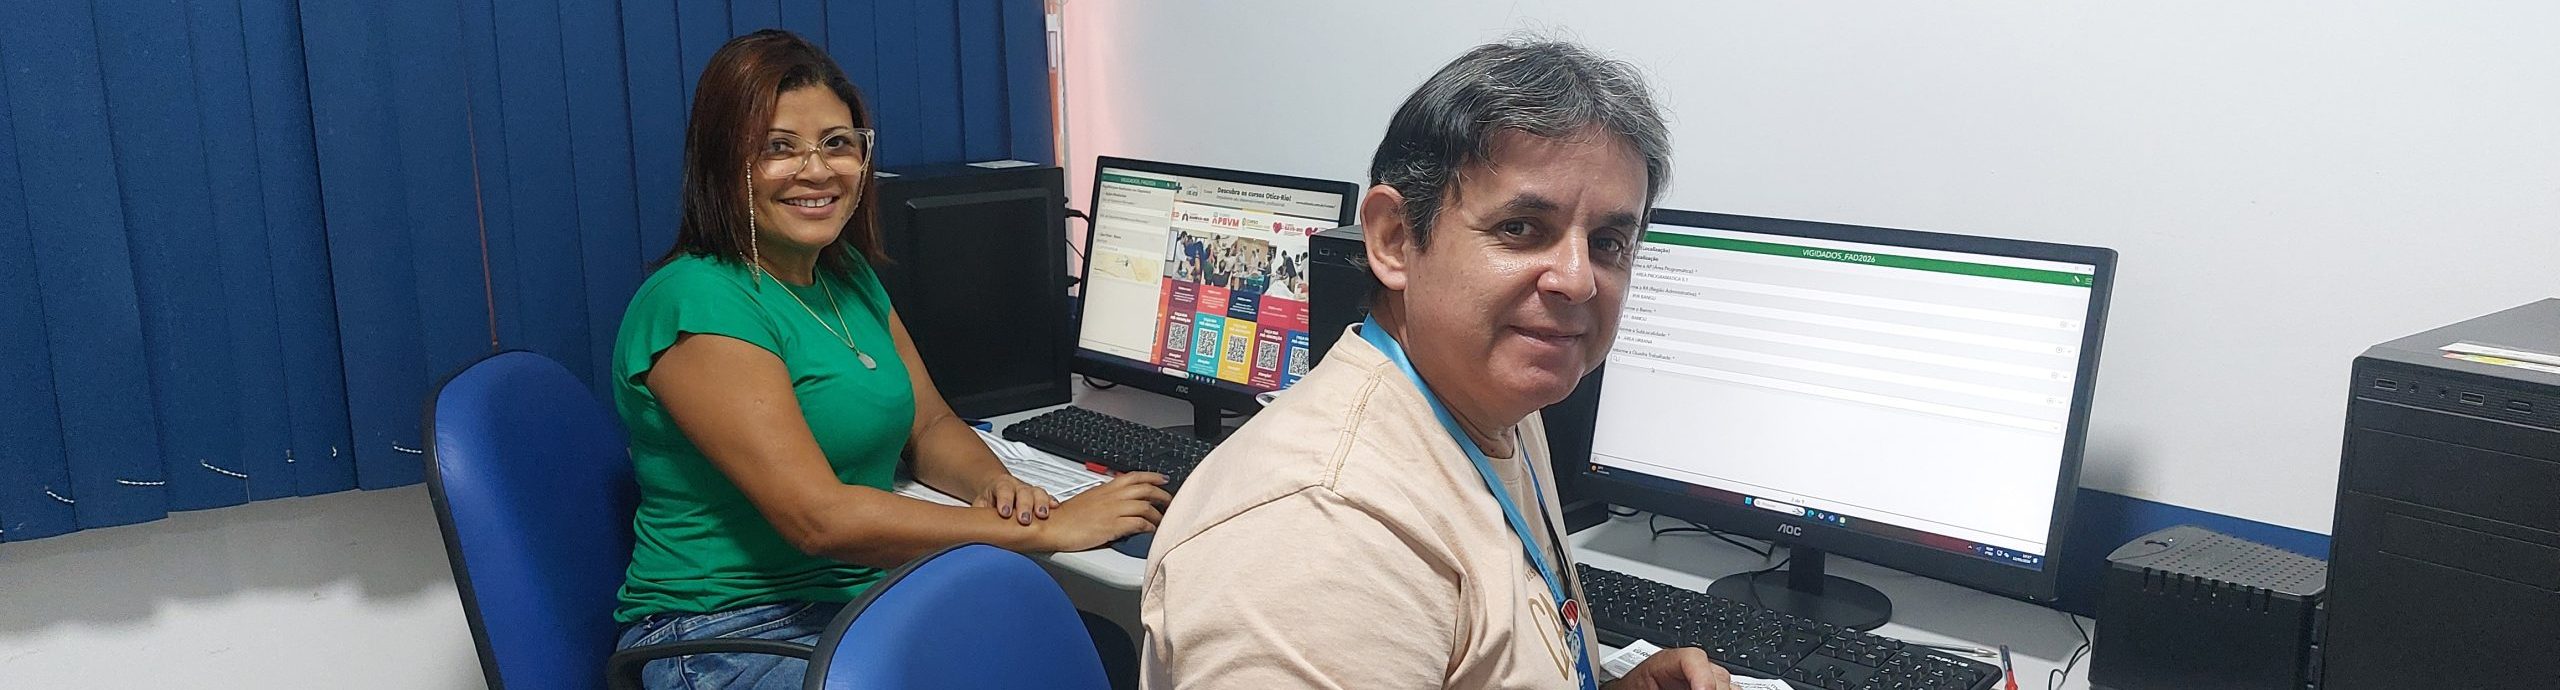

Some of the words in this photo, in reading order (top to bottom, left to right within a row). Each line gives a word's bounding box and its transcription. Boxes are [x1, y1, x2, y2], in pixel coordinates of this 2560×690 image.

[1217, 187, 1241, 196] Descubra
[1802, 249, 1876, 263] VIGIDADOS_FAD2026
[1175, 384, 1190, 394] AOC
[1777, 523, 1802, 537] AOC
